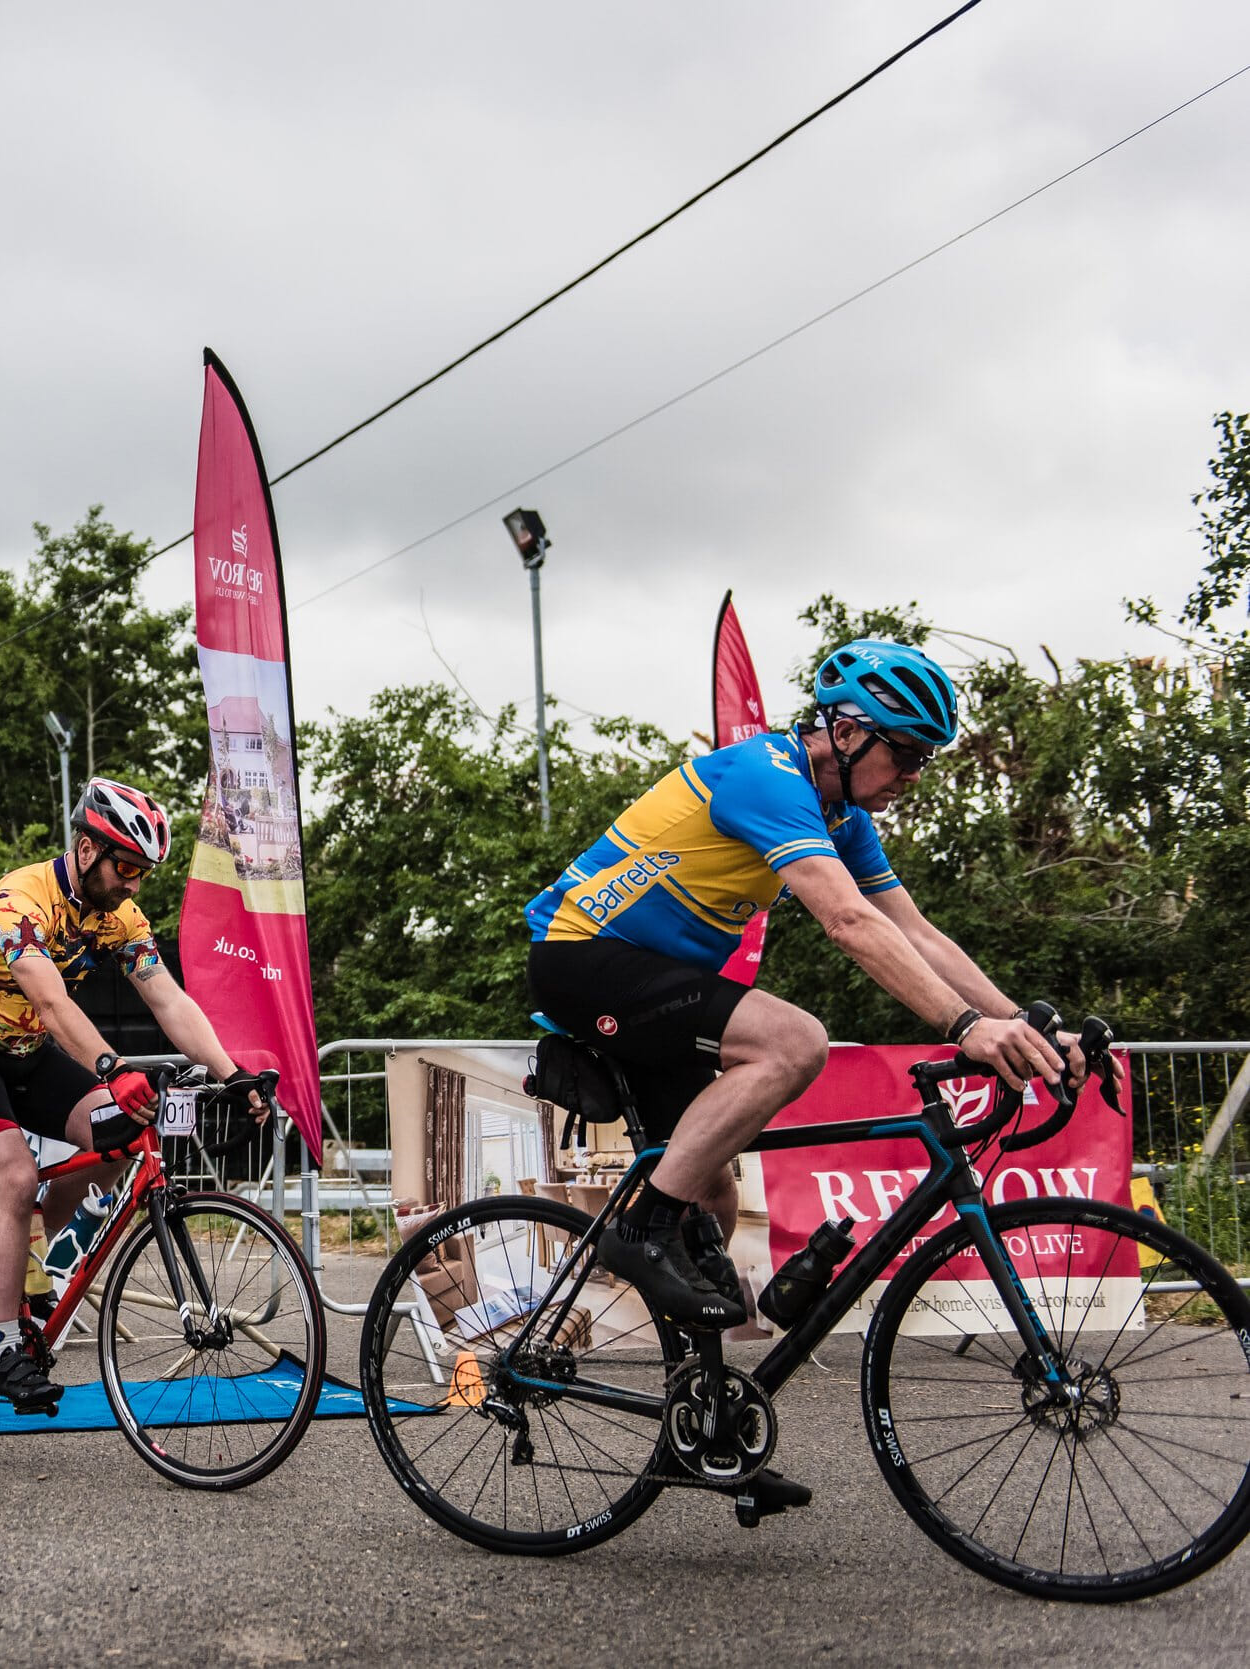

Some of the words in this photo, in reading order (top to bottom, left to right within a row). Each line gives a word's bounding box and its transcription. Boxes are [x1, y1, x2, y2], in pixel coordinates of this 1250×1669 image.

[576, 851, 681, 927] Barretts
[811, 1167, 1098, 1223] REOW
[456, 1216, 472, 1231] DT
[428, 1224, 455, 1248] SWISS
[1032, 1234, 1084, 1255] LIVE
[979, 1295, 1003, 1311] vis
[1031, 1291, 1106, 1309] edrow.co.uk
[878, 1408, 892, 1429] DT
[883, 1431, 906, 1468] SWISS
[566, 1524, 583, 1539] DT
[584, 1509, 613, 1533] SWISS
